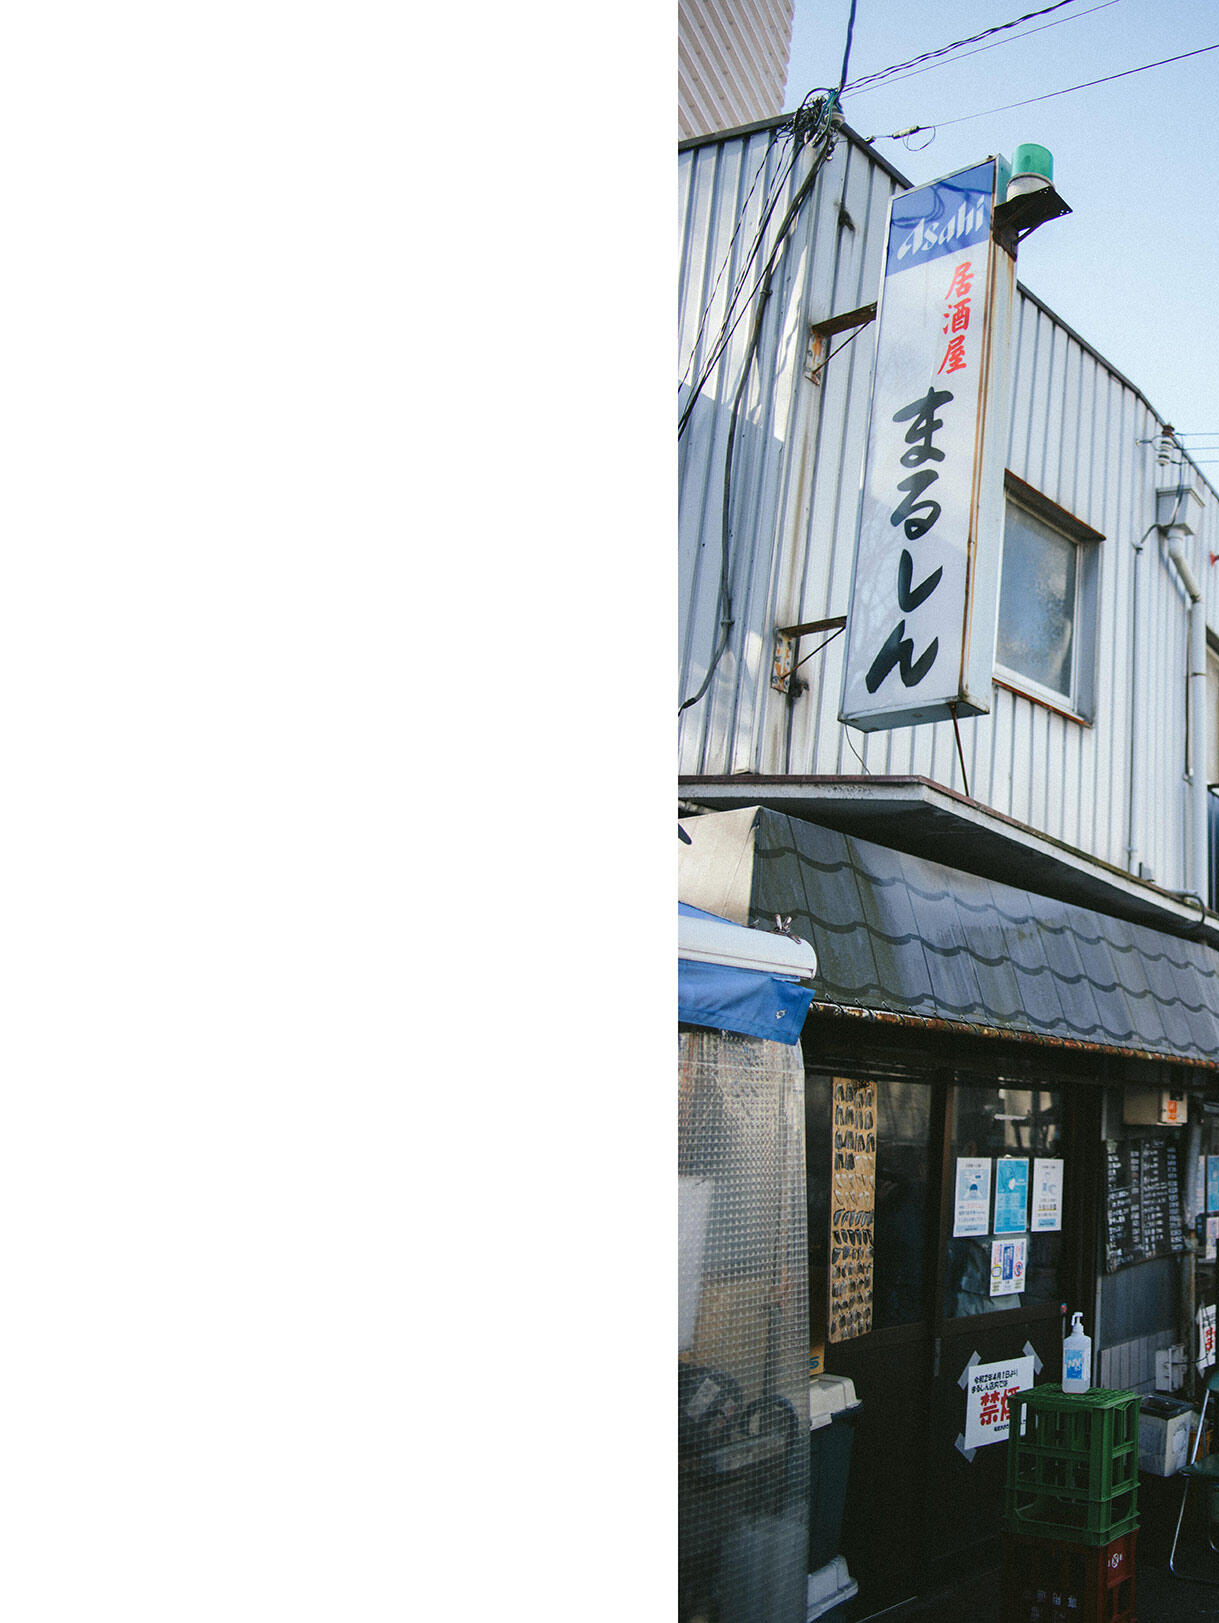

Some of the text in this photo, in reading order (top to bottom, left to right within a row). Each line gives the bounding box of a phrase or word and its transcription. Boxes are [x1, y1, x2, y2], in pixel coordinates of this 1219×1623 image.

[897, 194, 985, 260] Asahi
[937, 261, 974, 375] 居酒屋
[865, 386, 954, 694] まるしん
